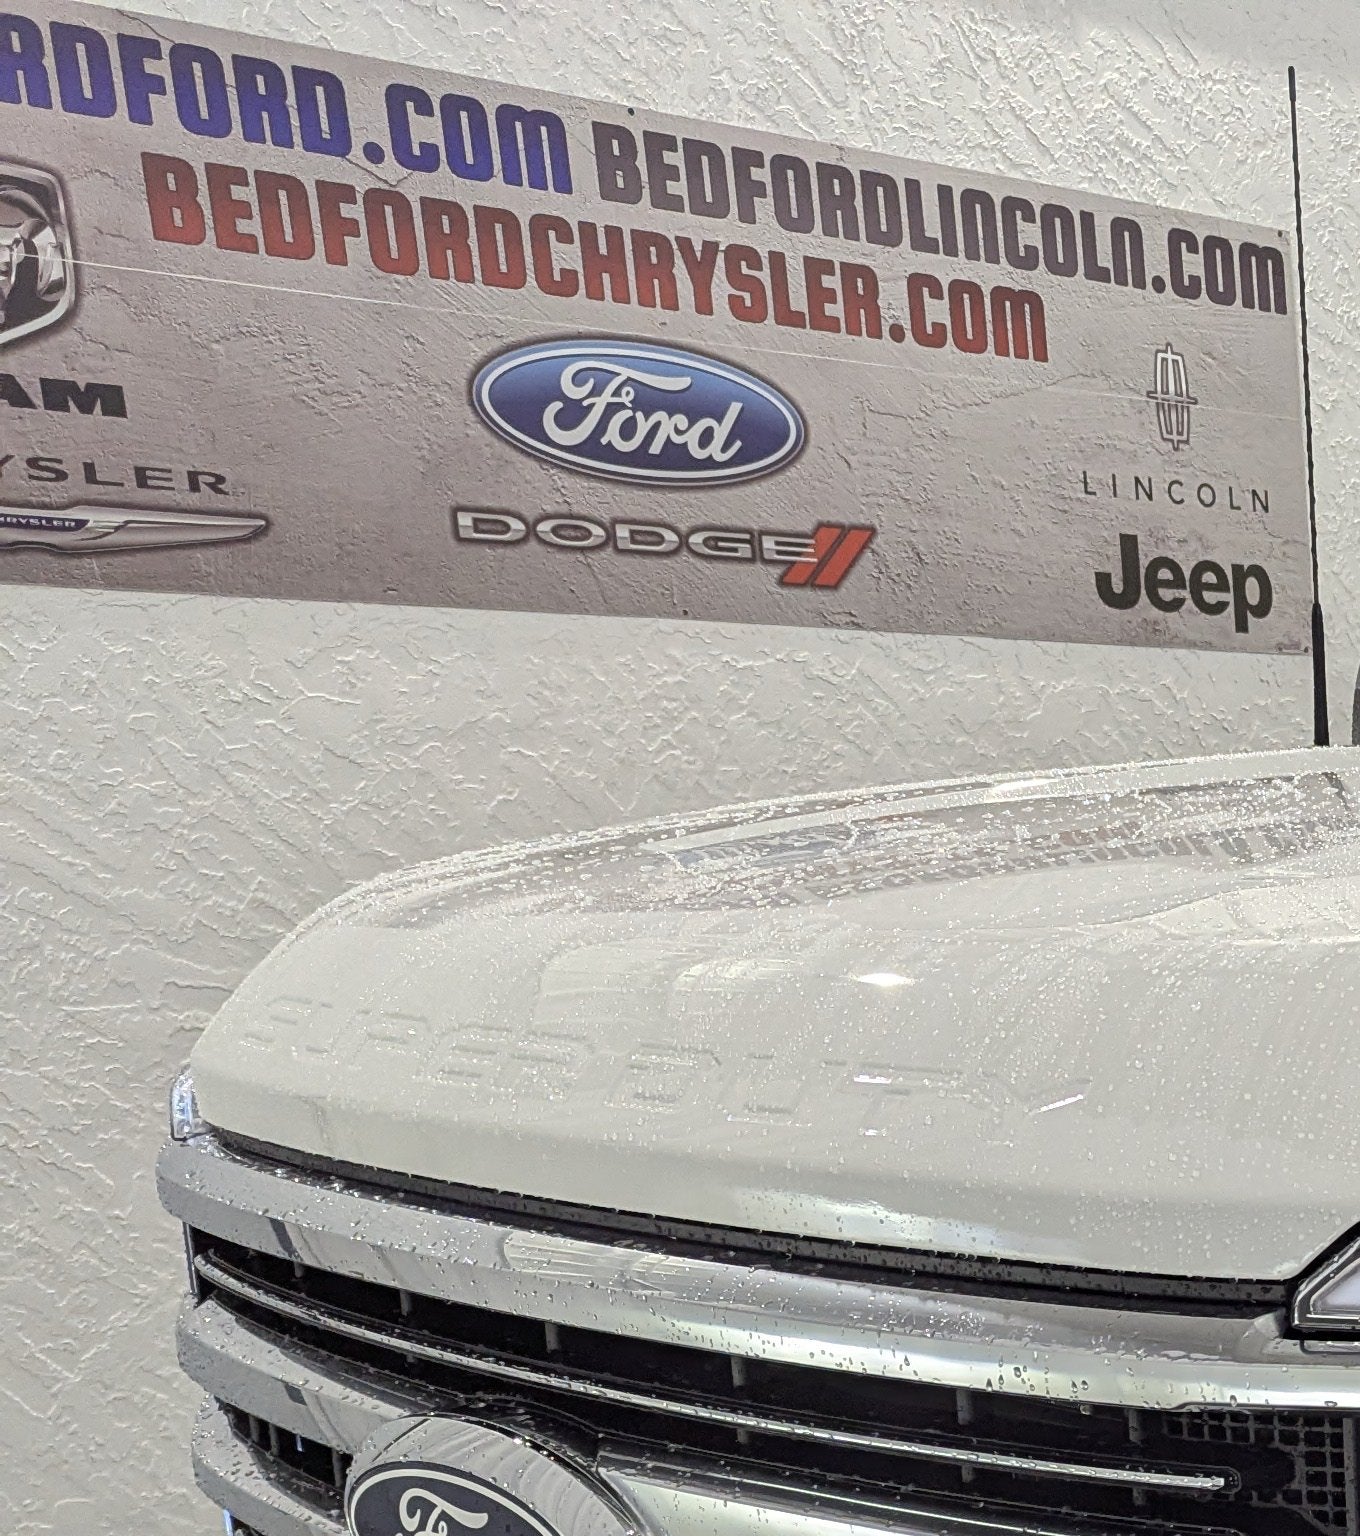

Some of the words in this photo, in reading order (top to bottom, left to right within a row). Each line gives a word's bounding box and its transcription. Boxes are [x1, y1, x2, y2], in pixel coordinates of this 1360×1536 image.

[140, 151, 1049, 363] BEDFORDCHRYSLER.COM
[591, 120, 1288, 315] BEDFORDLINCOLN.COM
[542, 360, 743, 462] Ford
[456, 510, 819, 564] DODGE
[1082, 470, 1270, 513] LINCOLN
[1095, 533, 1273, 634] Jeep
